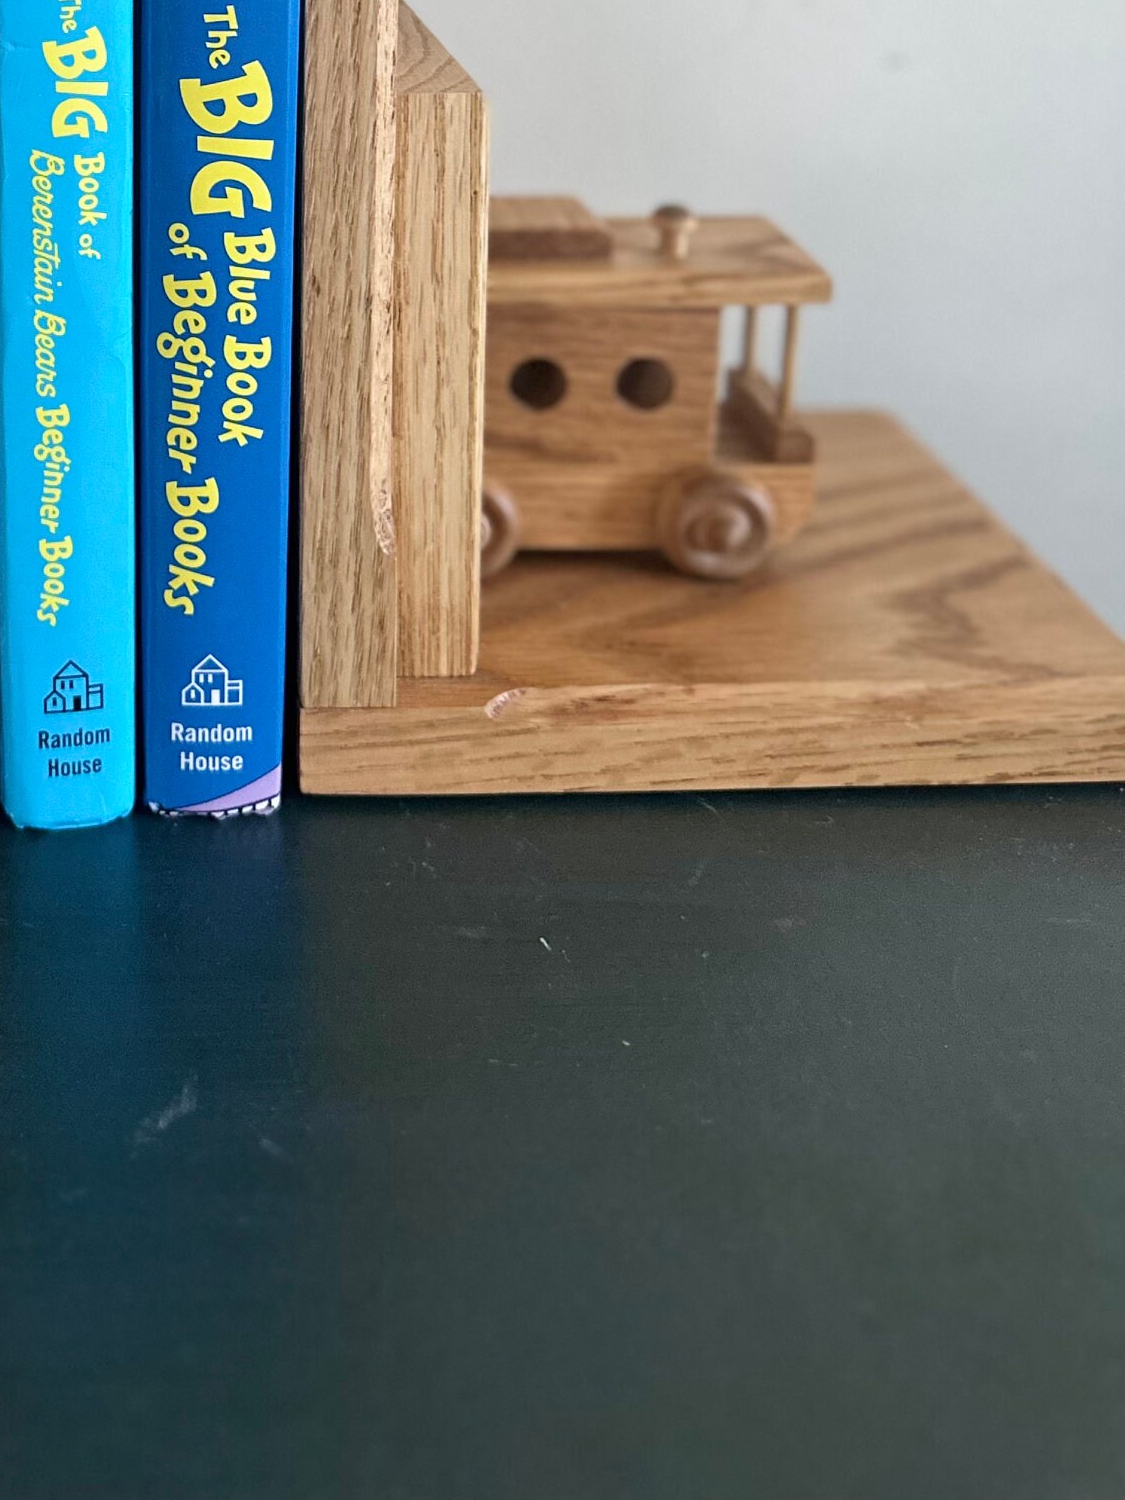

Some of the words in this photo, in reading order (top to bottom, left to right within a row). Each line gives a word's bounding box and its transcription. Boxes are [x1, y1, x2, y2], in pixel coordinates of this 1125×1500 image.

[42, 26, 109, 139] BIG
[203, 5, 239, 69] The
[179, 59, 275, 219] BIG
[29, 149, 66, 304] Berenstain
[73, 152, 108, 226] Book
[78, 233, 101, 260] of
[168, 222, 208, 261] of
[224, 227, 276, 325] Blue
[33, 308, 67, 398] Bears
[156, 271, 218, 475] Beginner
[218, 335, 272, 447] Book
[33, 403, 71, 534] Beginner
[36, 535, 74, 627] Books
[163, 476, 220, 616] Books
[38, 727, 111, 750] Random
[47, 758, 103, 778] House
[171, 723, 253, 743] Random
[180, 752, 244, 772] House
